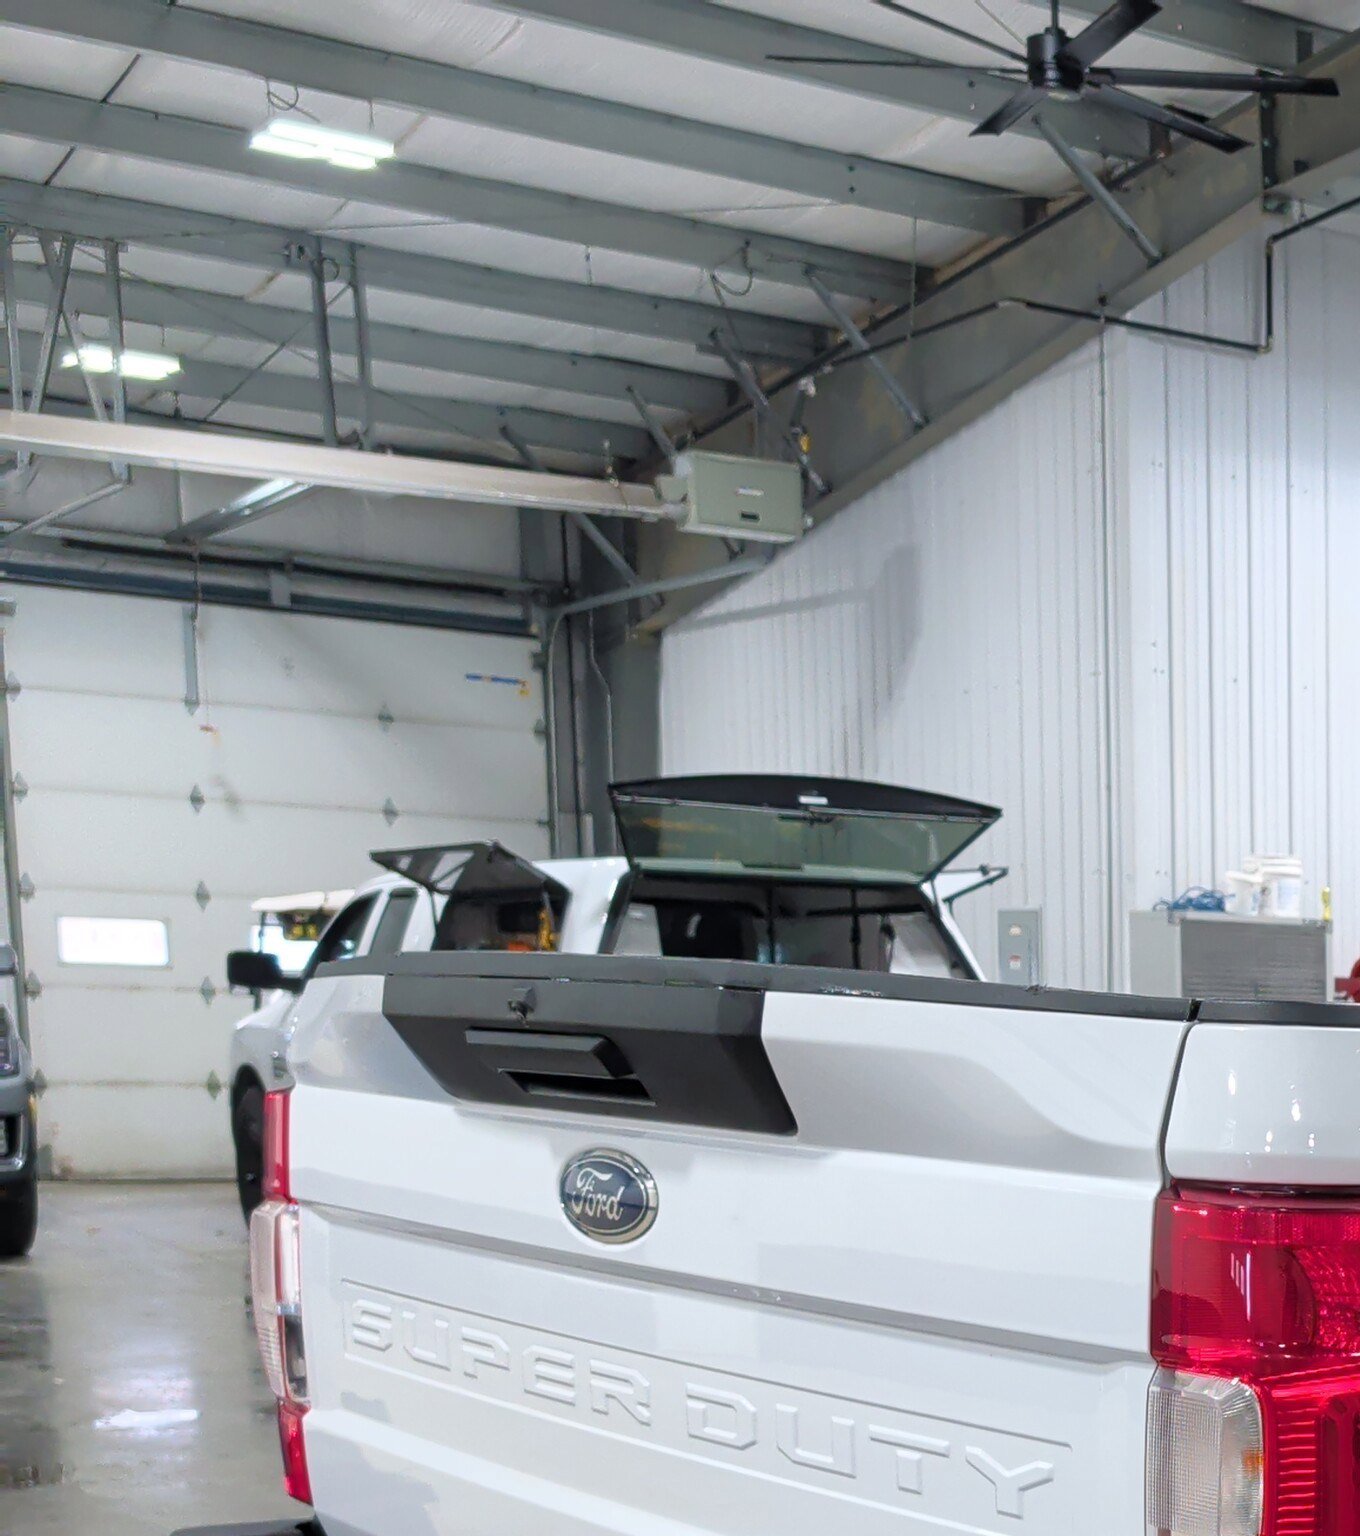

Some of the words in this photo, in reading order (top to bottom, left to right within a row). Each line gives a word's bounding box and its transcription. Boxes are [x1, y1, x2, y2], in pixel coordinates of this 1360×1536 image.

[571, 1167, 626, 1221] Ford
[350, 1296, 651, 1427] SUPER
[685, 1382, 1055, 1520] DUTY
